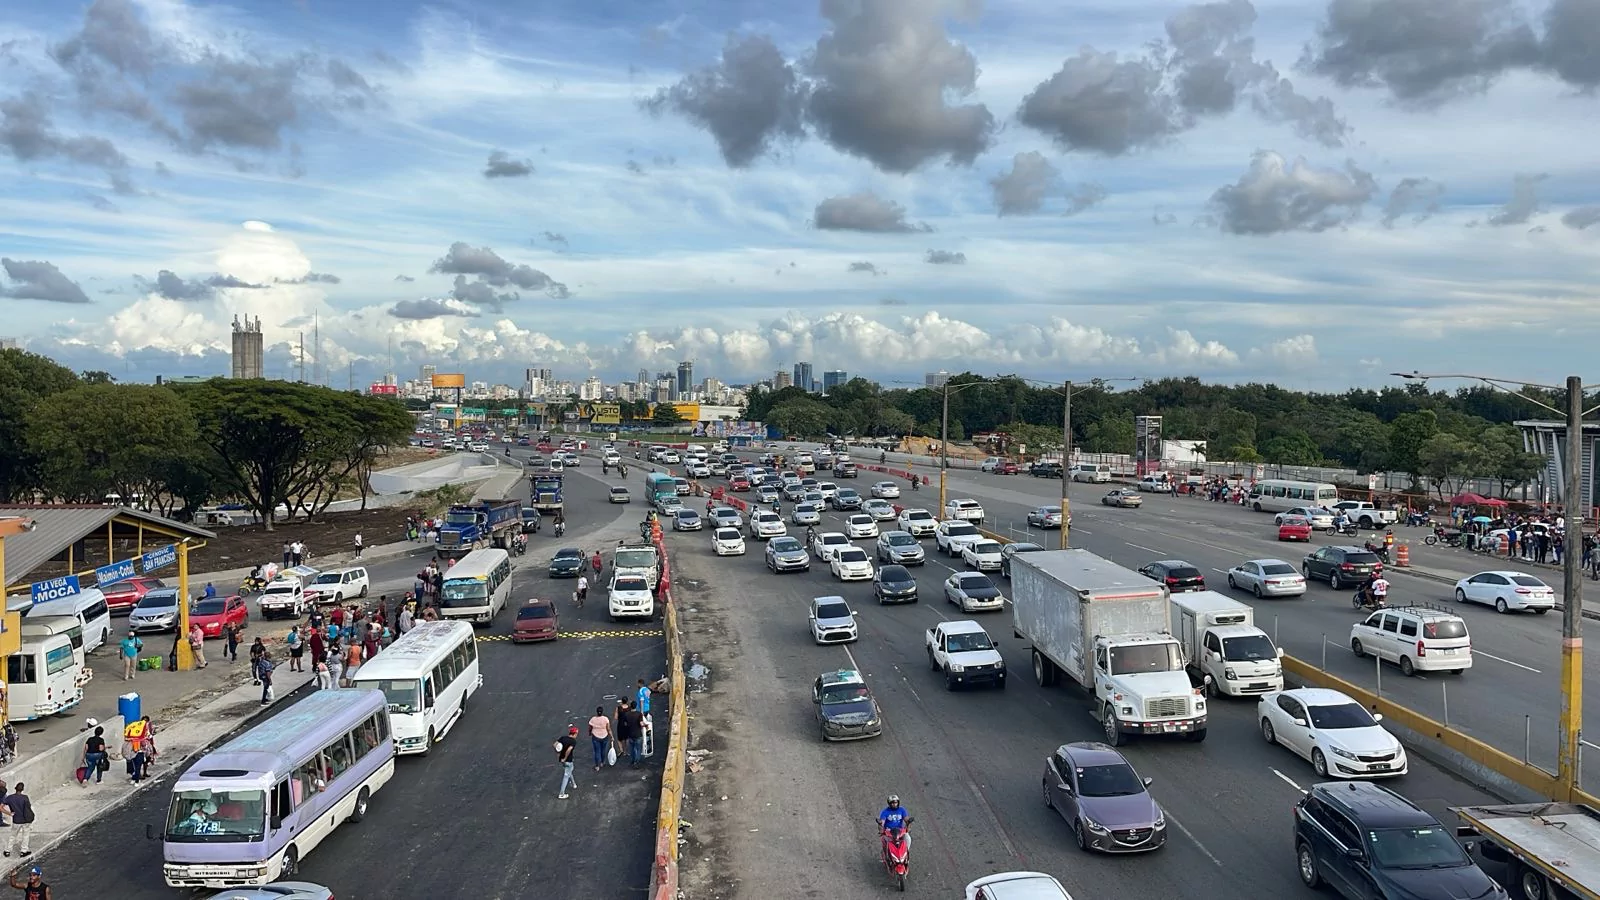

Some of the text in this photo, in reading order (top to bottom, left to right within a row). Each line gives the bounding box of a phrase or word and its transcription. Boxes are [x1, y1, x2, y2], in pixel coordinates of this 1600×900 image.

[40, 577, 68, 591] LA VEGA
[37, 585, 76, 602] MOCA
[195, 822, 218, 833] 27-B
